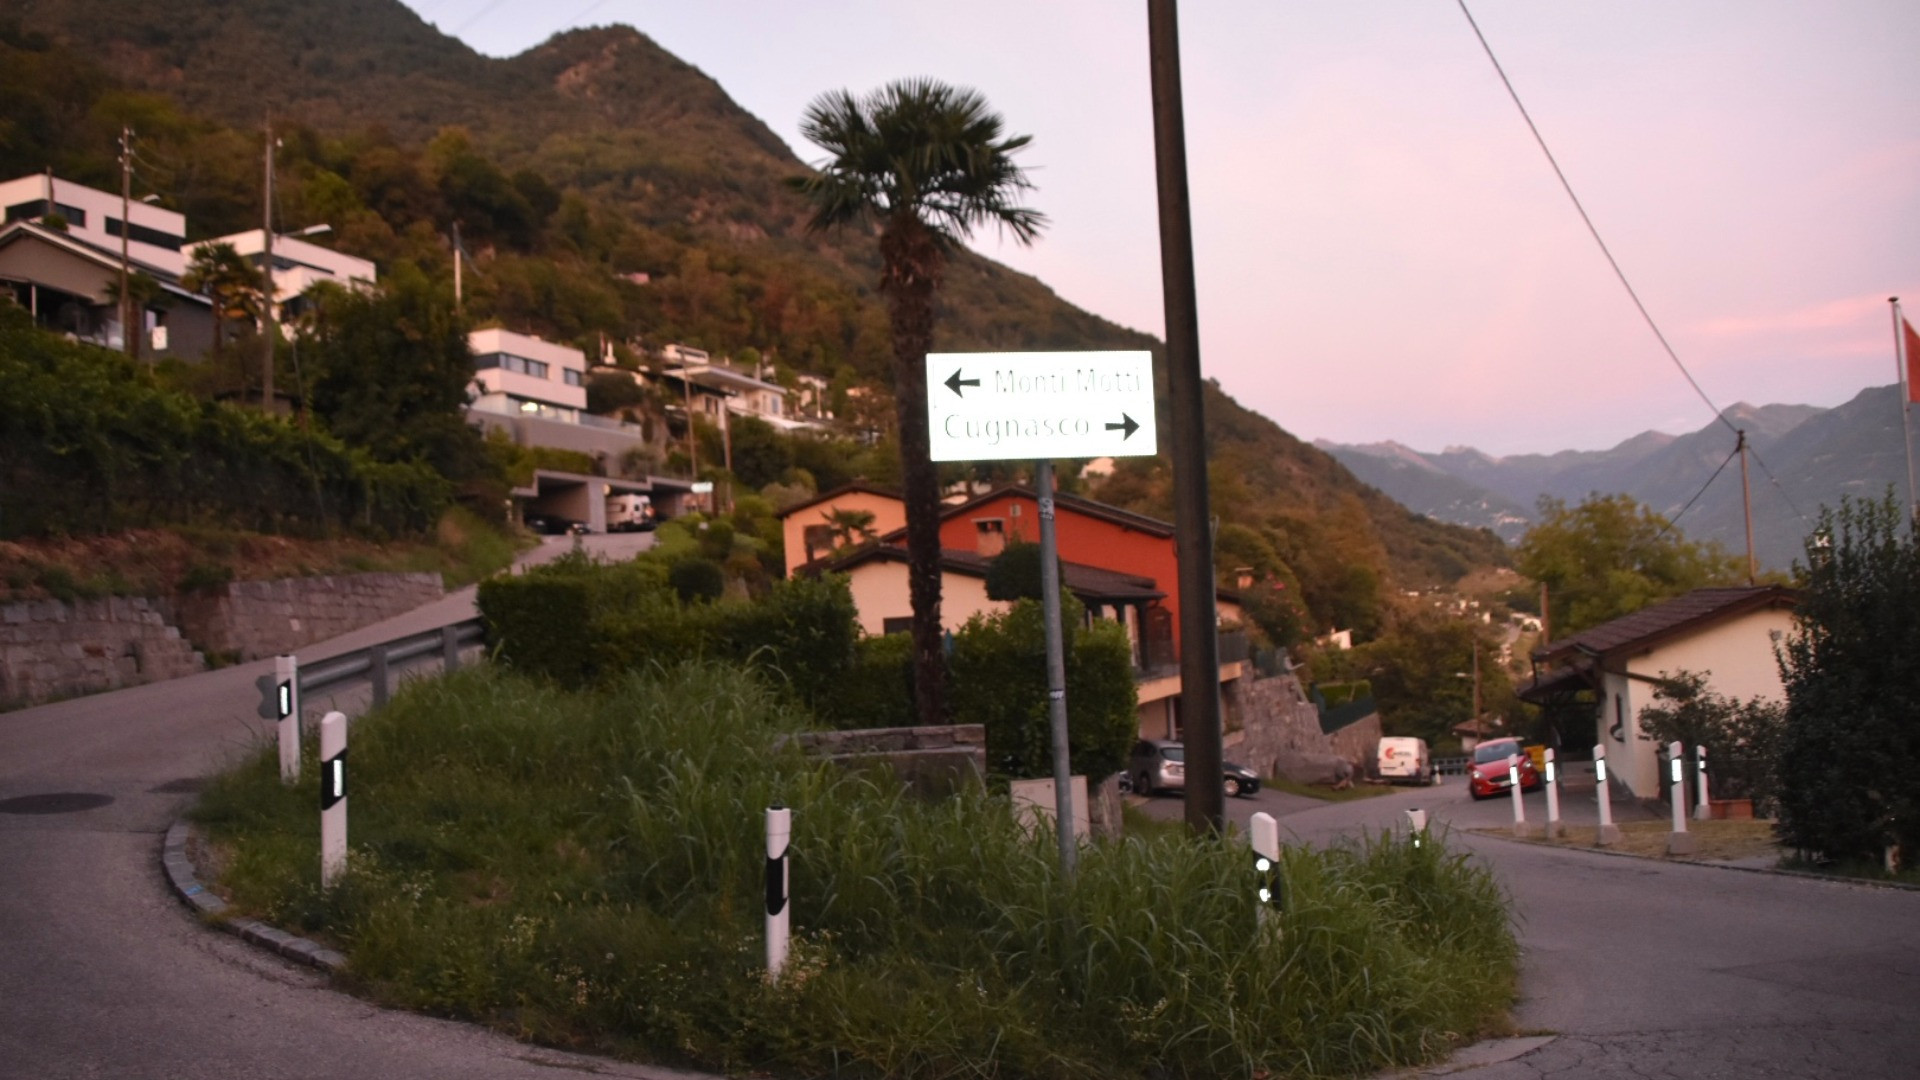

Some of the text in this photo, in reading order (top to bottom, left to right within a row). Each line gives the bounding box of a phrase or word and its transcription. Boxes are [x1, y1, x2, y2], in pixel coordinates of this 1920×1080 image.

[994, 366, 1141, 393] Monti Motti
[944, 413, 1090, 446] Cugnasco
